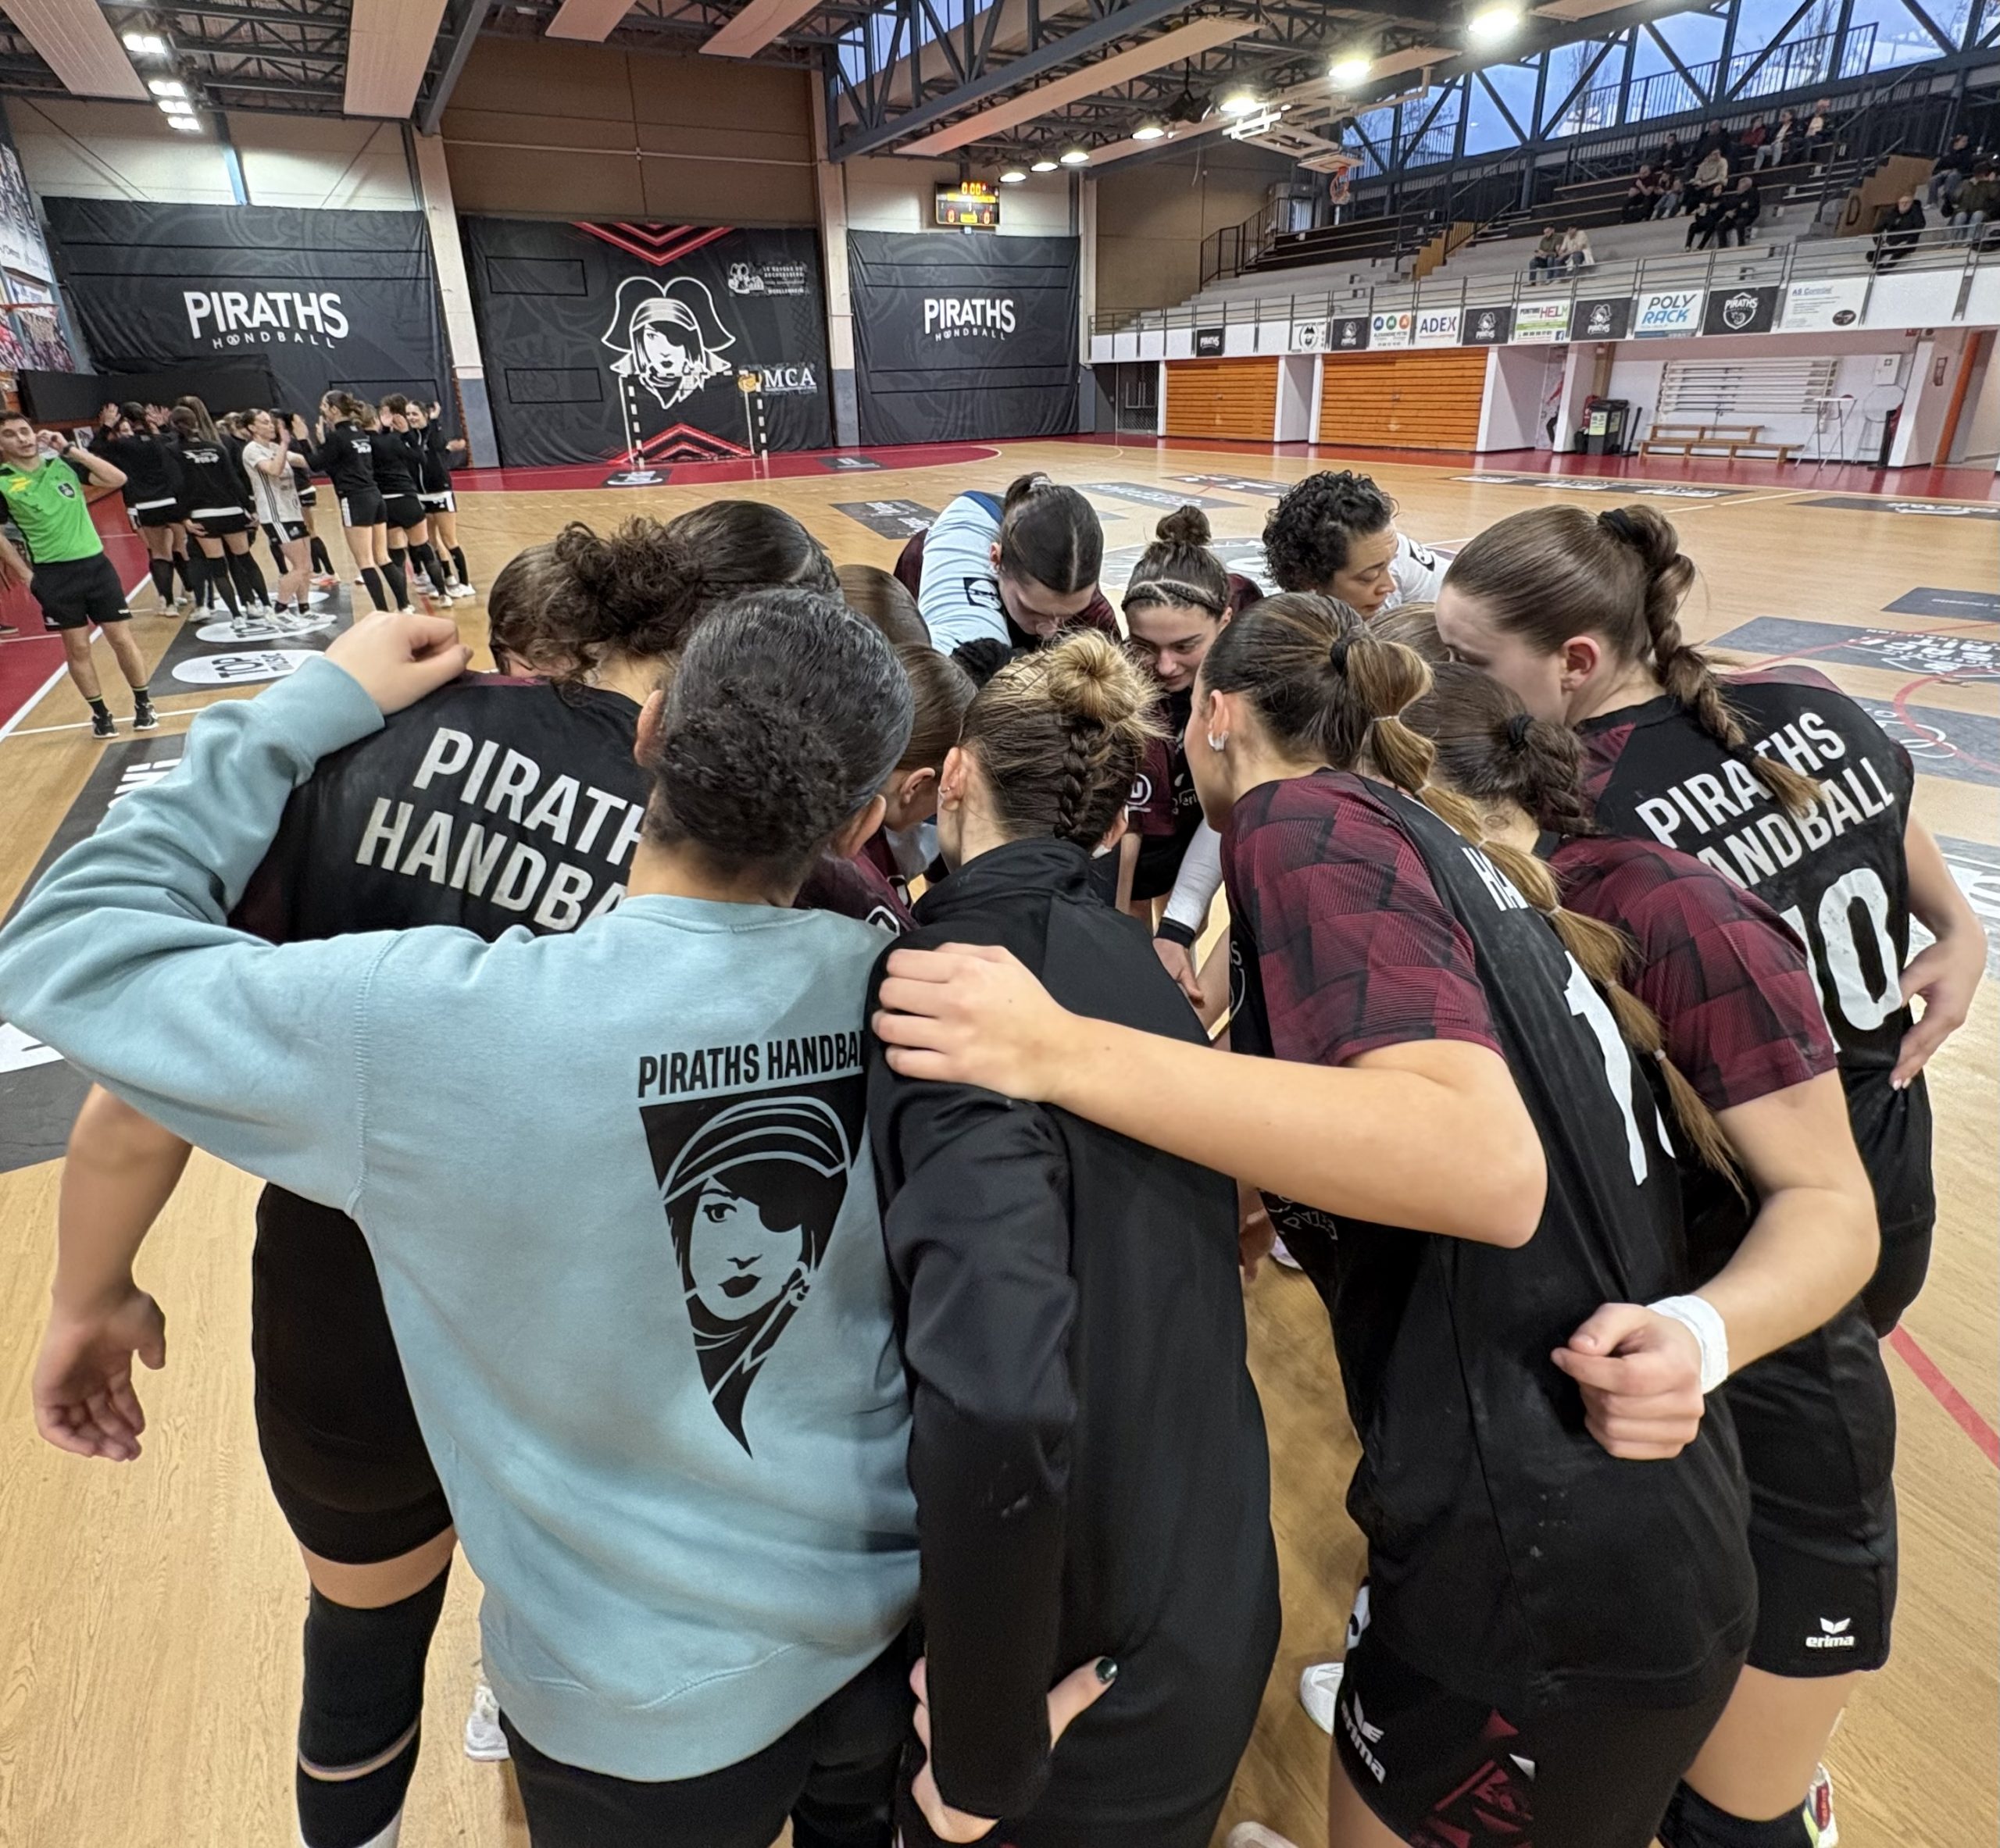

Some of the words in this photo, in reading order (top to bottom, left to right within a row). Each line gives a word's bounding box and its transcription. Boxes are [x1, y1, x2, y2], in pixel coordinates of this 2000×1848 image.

[1648, 294, 1697, 310] POLY
[1724, 298, 1759, 311] PIRATHS
[184, 291, 349, 339] PIRATHS
[924, 298, 1016, 334] PIRATHS
[1420, 316, 1457, 334] ADEX
[1641, 309, 1690, 325] RACK
[763, 367, 816, 388] MCA
[211, 657, 270, 678] TOP
[412, 727, 645, 866] PIRATH
[638, 1043, 760, 1098] PIRATHS
[767, 1029, 864, 1080] HANDBA
[1805, 1635, 1855, 1648] erima
[1341, 1700, 1386, 1785] erima
